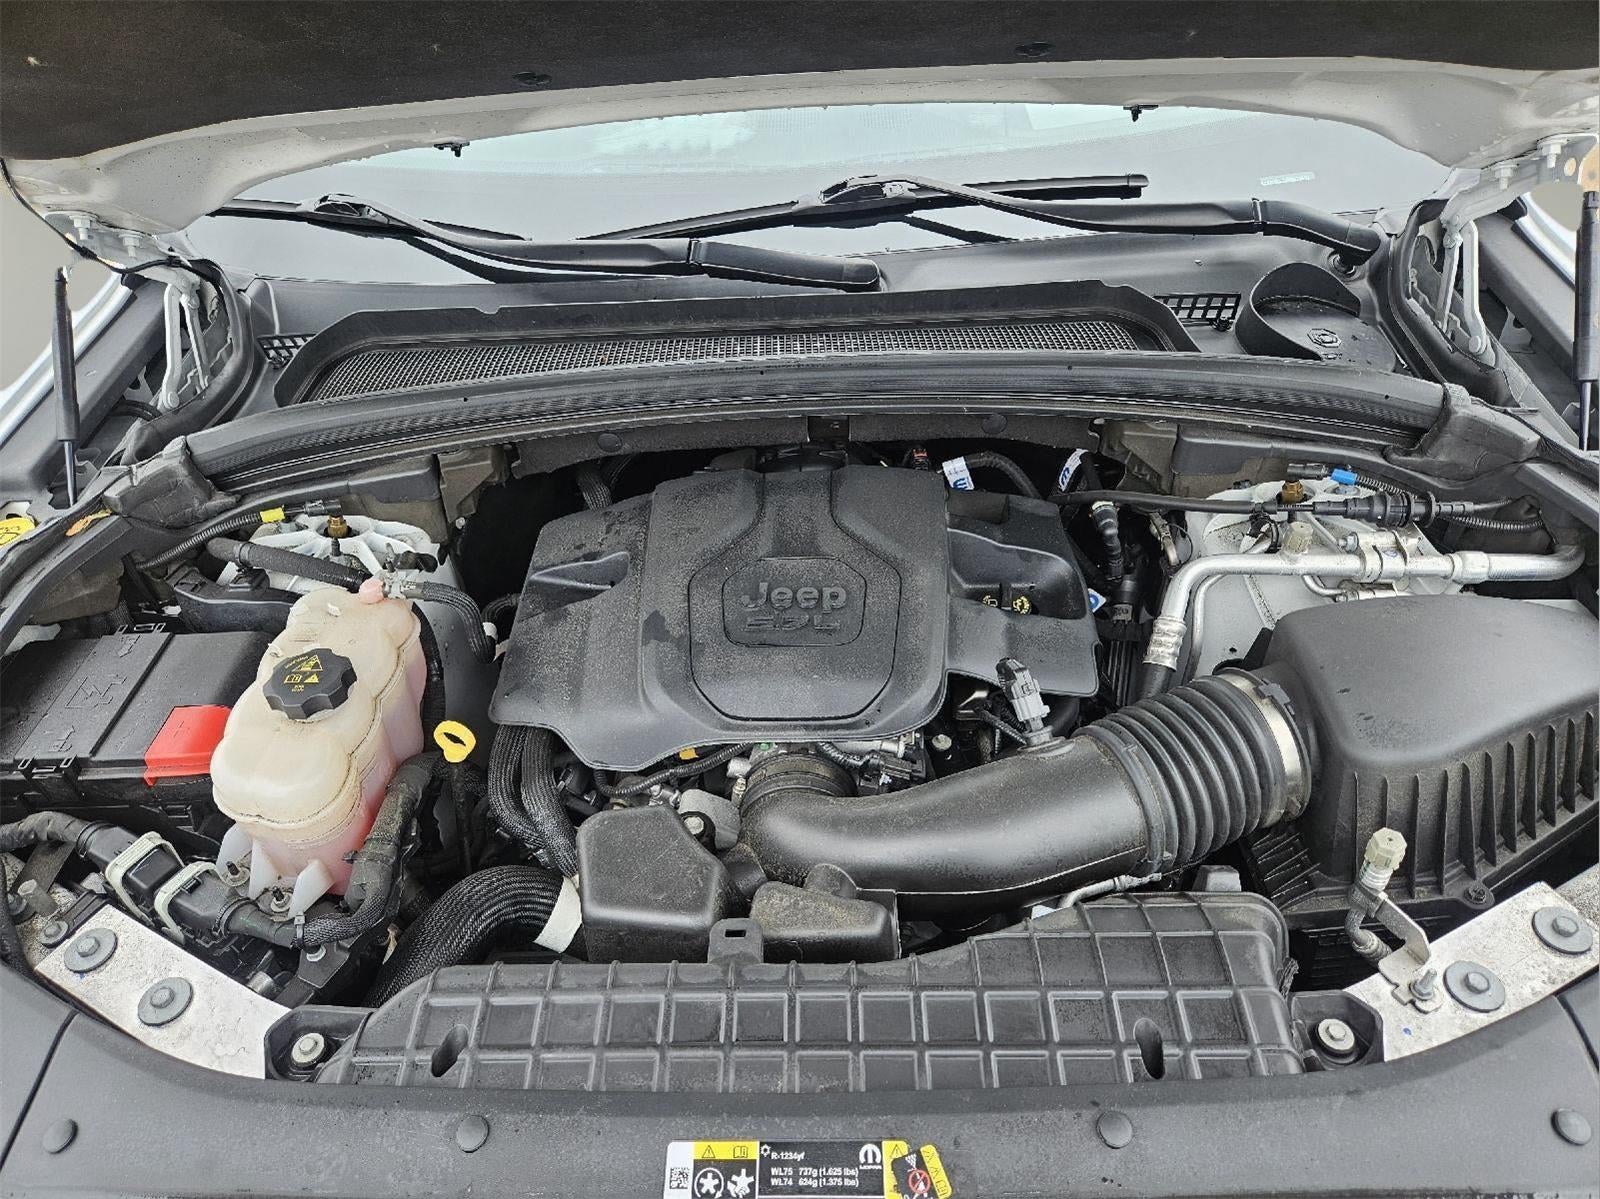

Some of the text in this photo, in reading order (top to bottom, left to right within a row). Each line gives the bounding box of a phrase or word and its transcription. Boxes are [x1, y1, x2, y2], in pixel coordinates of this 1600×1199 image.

[740, 582, 847, 613] Jeep
[771, 1151, 806, 1161] R-1234yf
[770, 1167, 859, 1177] WL75 737g (1.625 lbs)
[770, 1178, 793, 1186] WL74
[819, 1178, 842, 1187] (1.375
